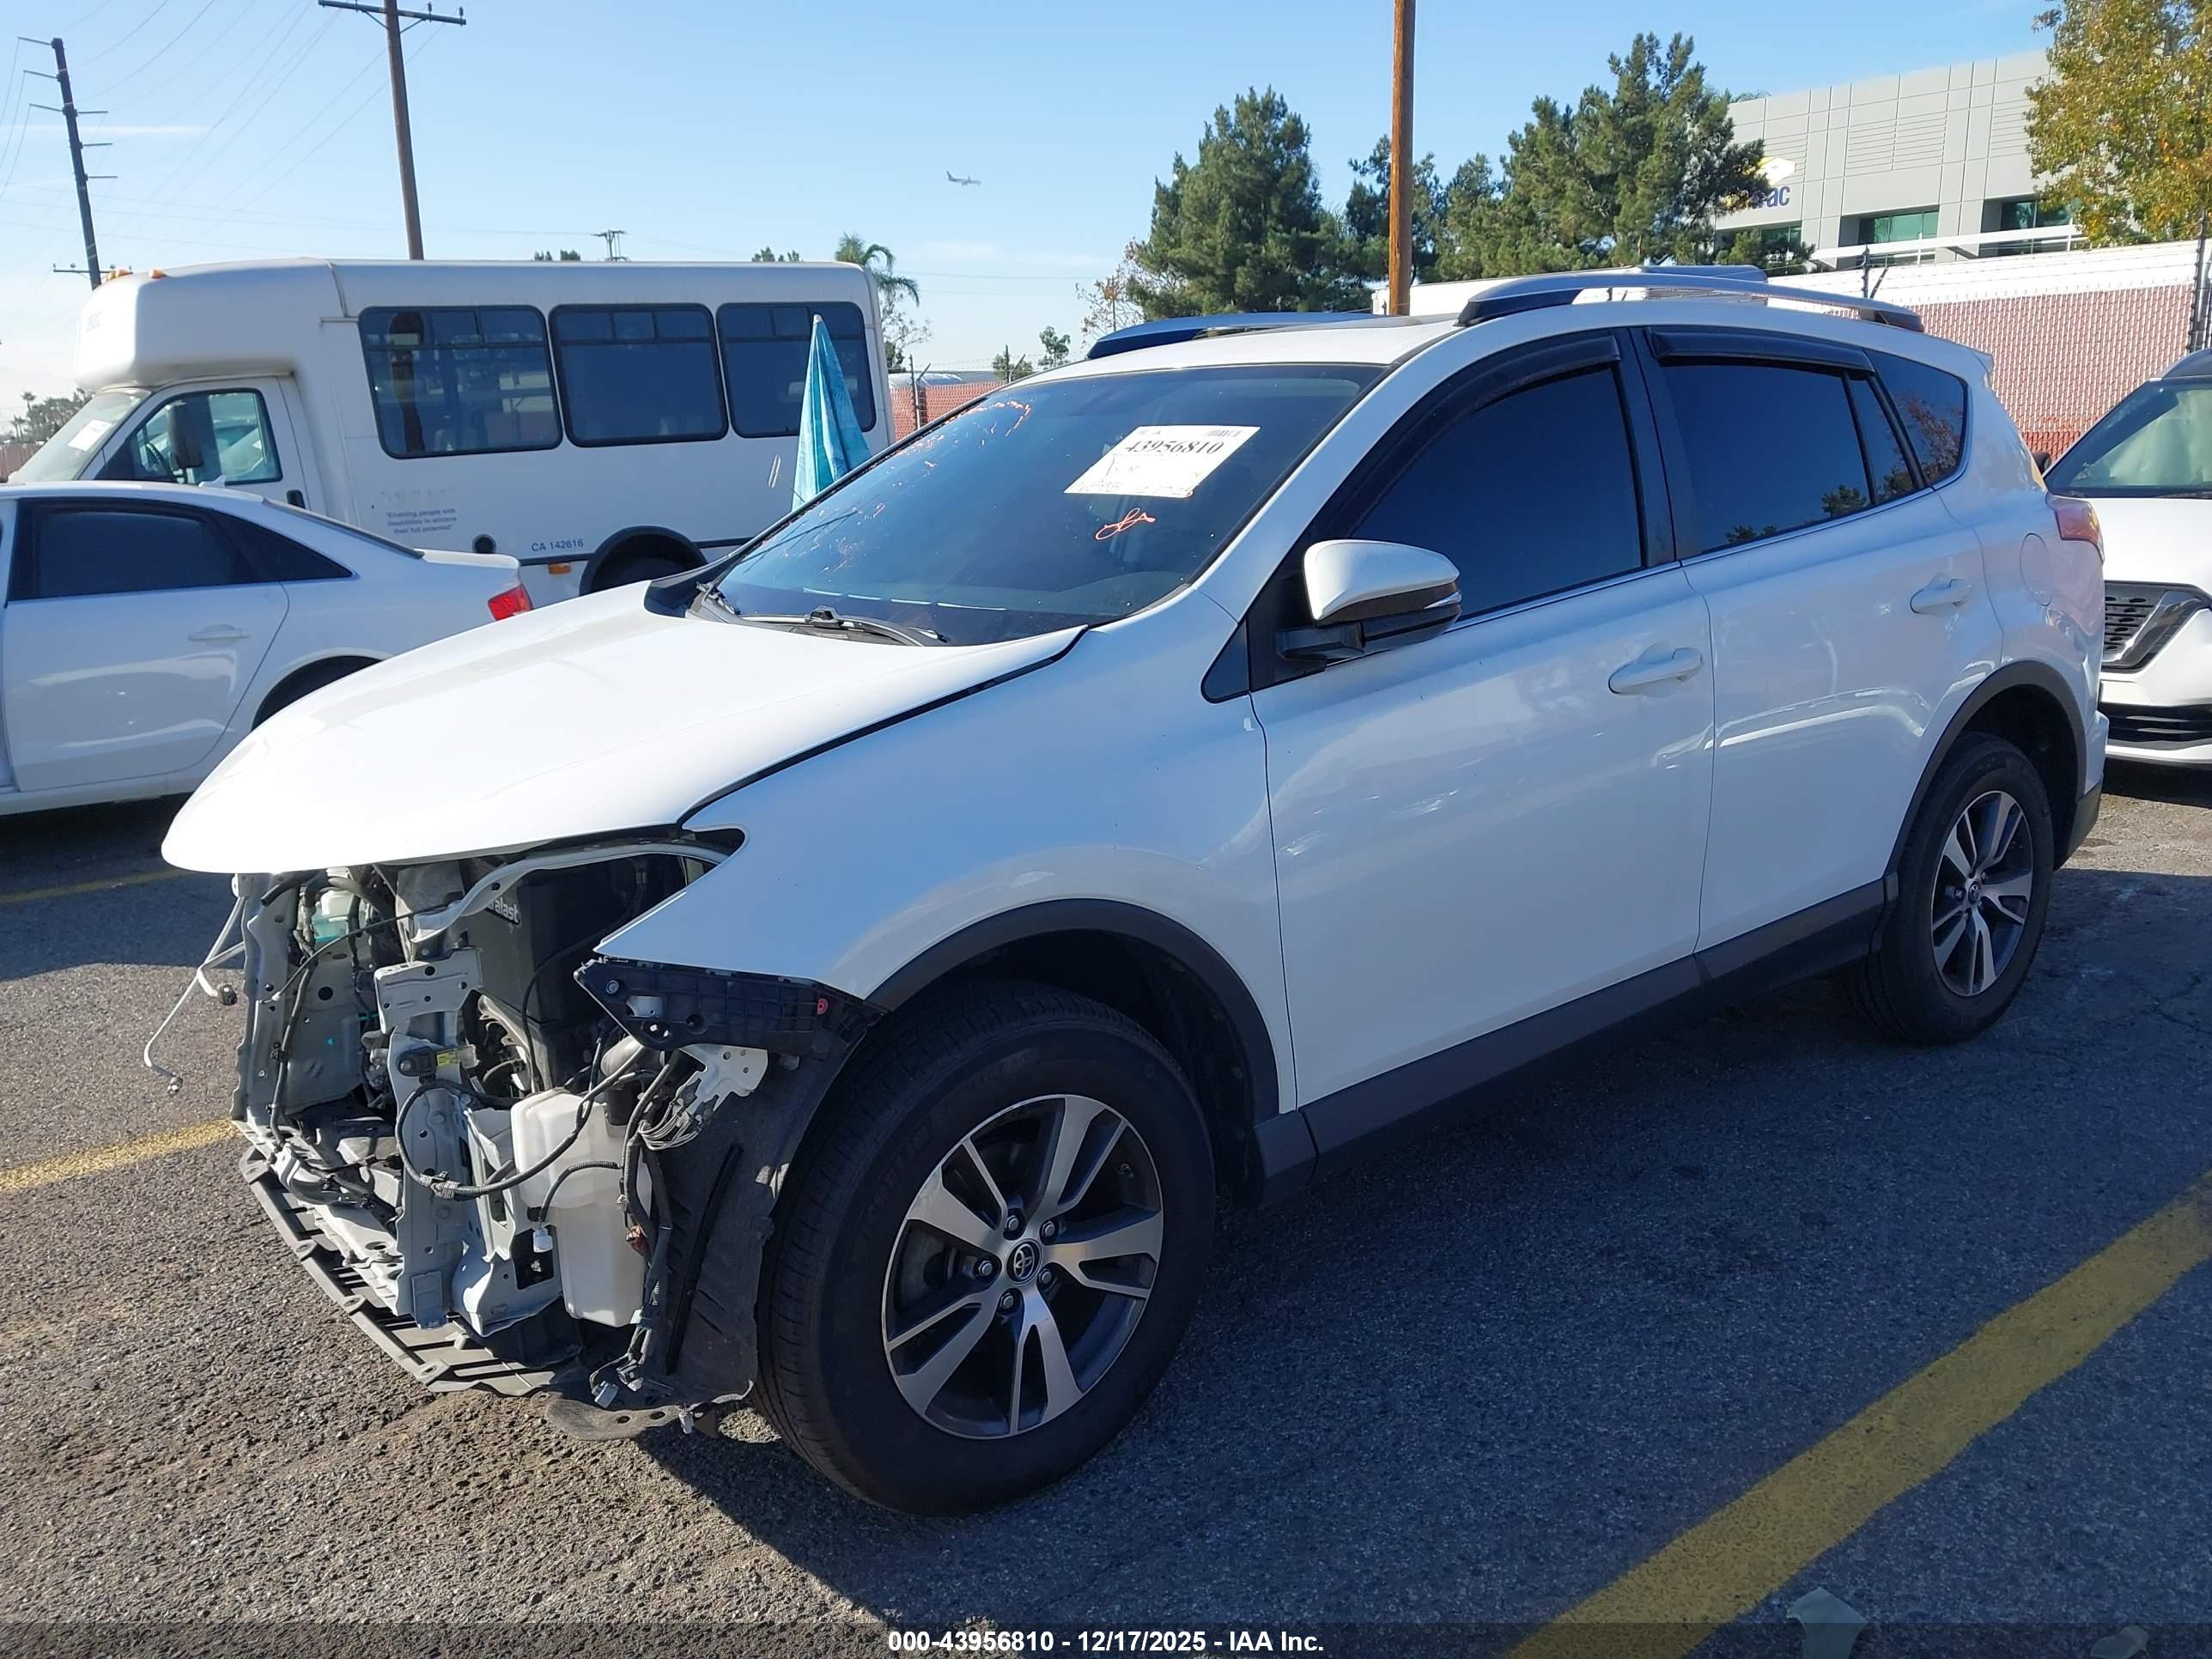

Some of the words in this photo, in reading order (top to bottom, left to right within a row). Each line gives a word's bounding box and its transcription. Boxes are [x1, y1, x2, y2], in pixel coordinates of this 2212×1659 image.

[1125, 440, 1224, 454] 43956810
[532, 542, 547, 551] CA
[550, 538, 584, 550] 142616
